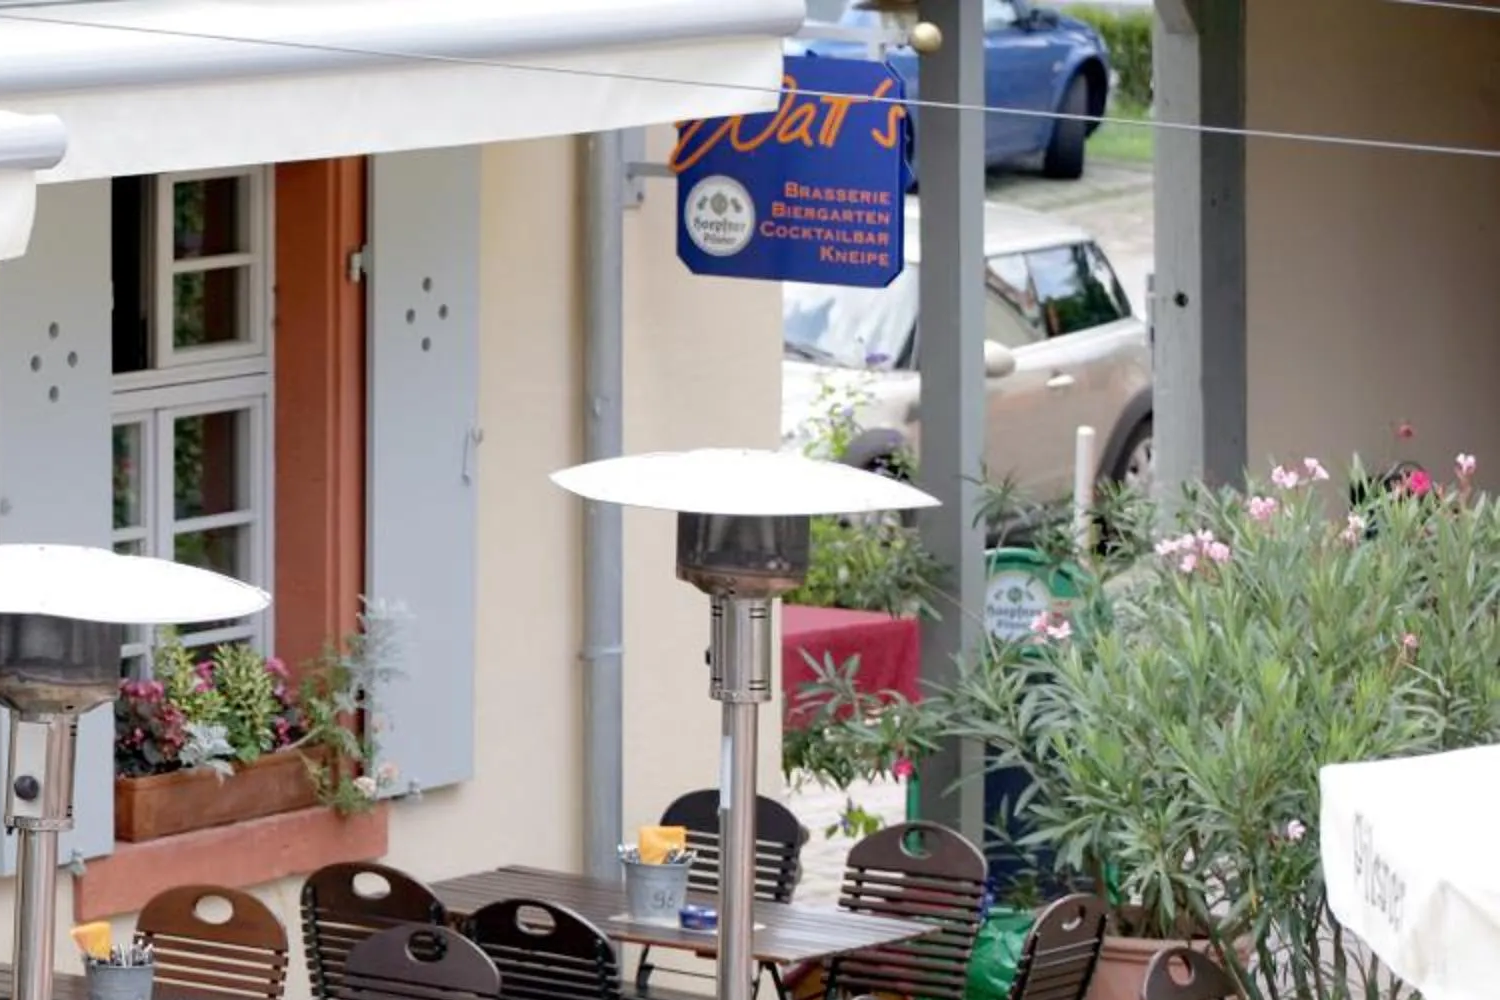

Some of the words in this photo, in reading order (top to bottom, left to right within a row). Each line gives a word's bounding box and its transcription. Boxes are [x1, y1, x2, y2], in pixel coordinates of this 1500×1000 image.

[784, 181, 891, 205] BRASSERIE
[771, 201, 890, 225] BIERGARTEN
[760, 221, 890, 246] COCKTAILBAR
[820, 245, 889, 268] KNEIPE
